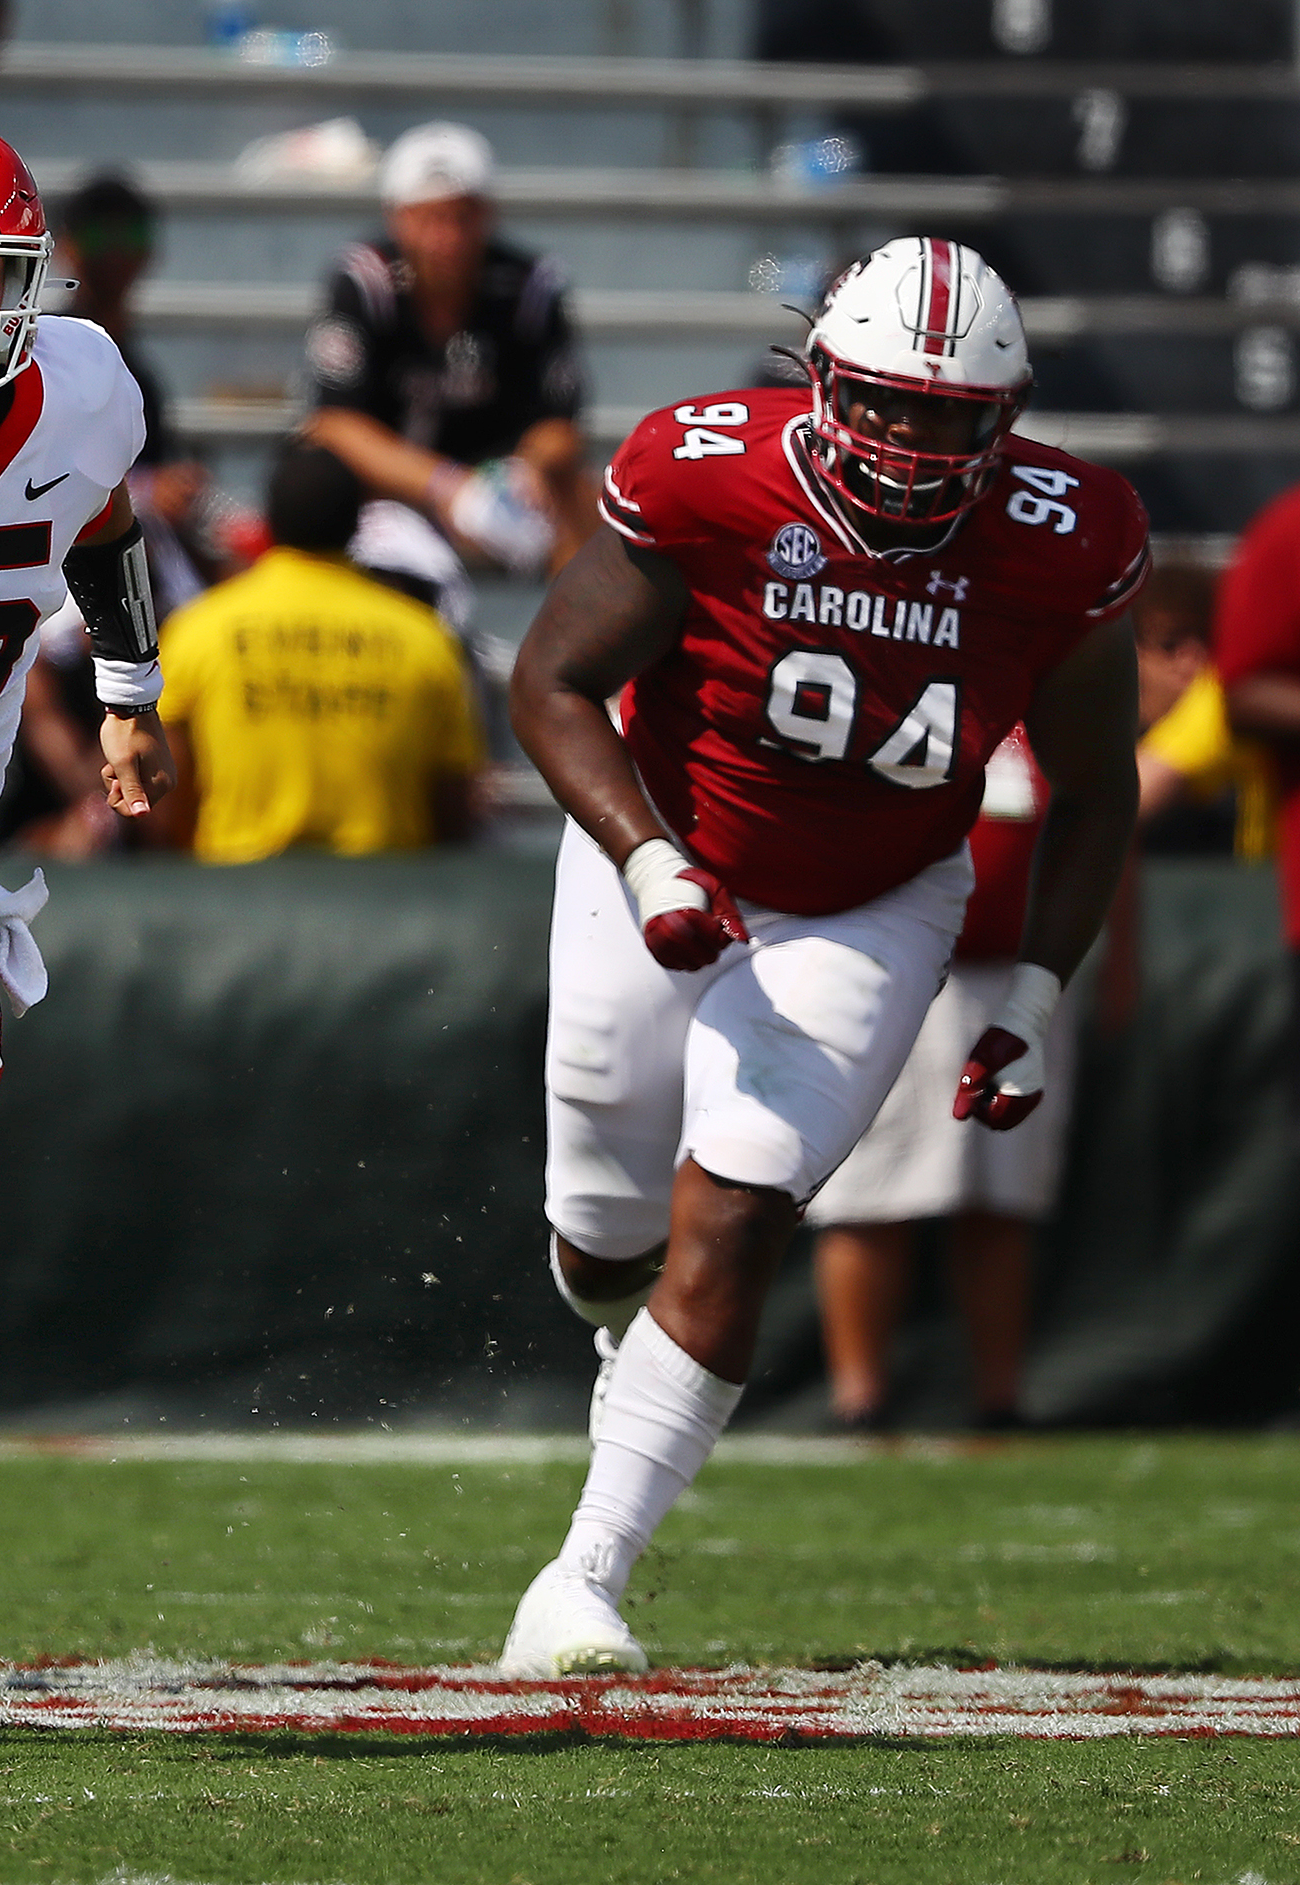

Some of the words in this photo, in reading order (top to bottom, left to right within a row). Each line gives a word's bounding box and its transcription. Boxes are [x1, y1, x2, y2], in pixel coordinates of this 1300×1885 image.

[673, 402, 750, 460] 94
[1006, 464, 1081, 534] 94
[779, 526, 817, 565] SEC
[762, 581, 962, 650] CAROLINA
[756, 649, 957, 789] 94
